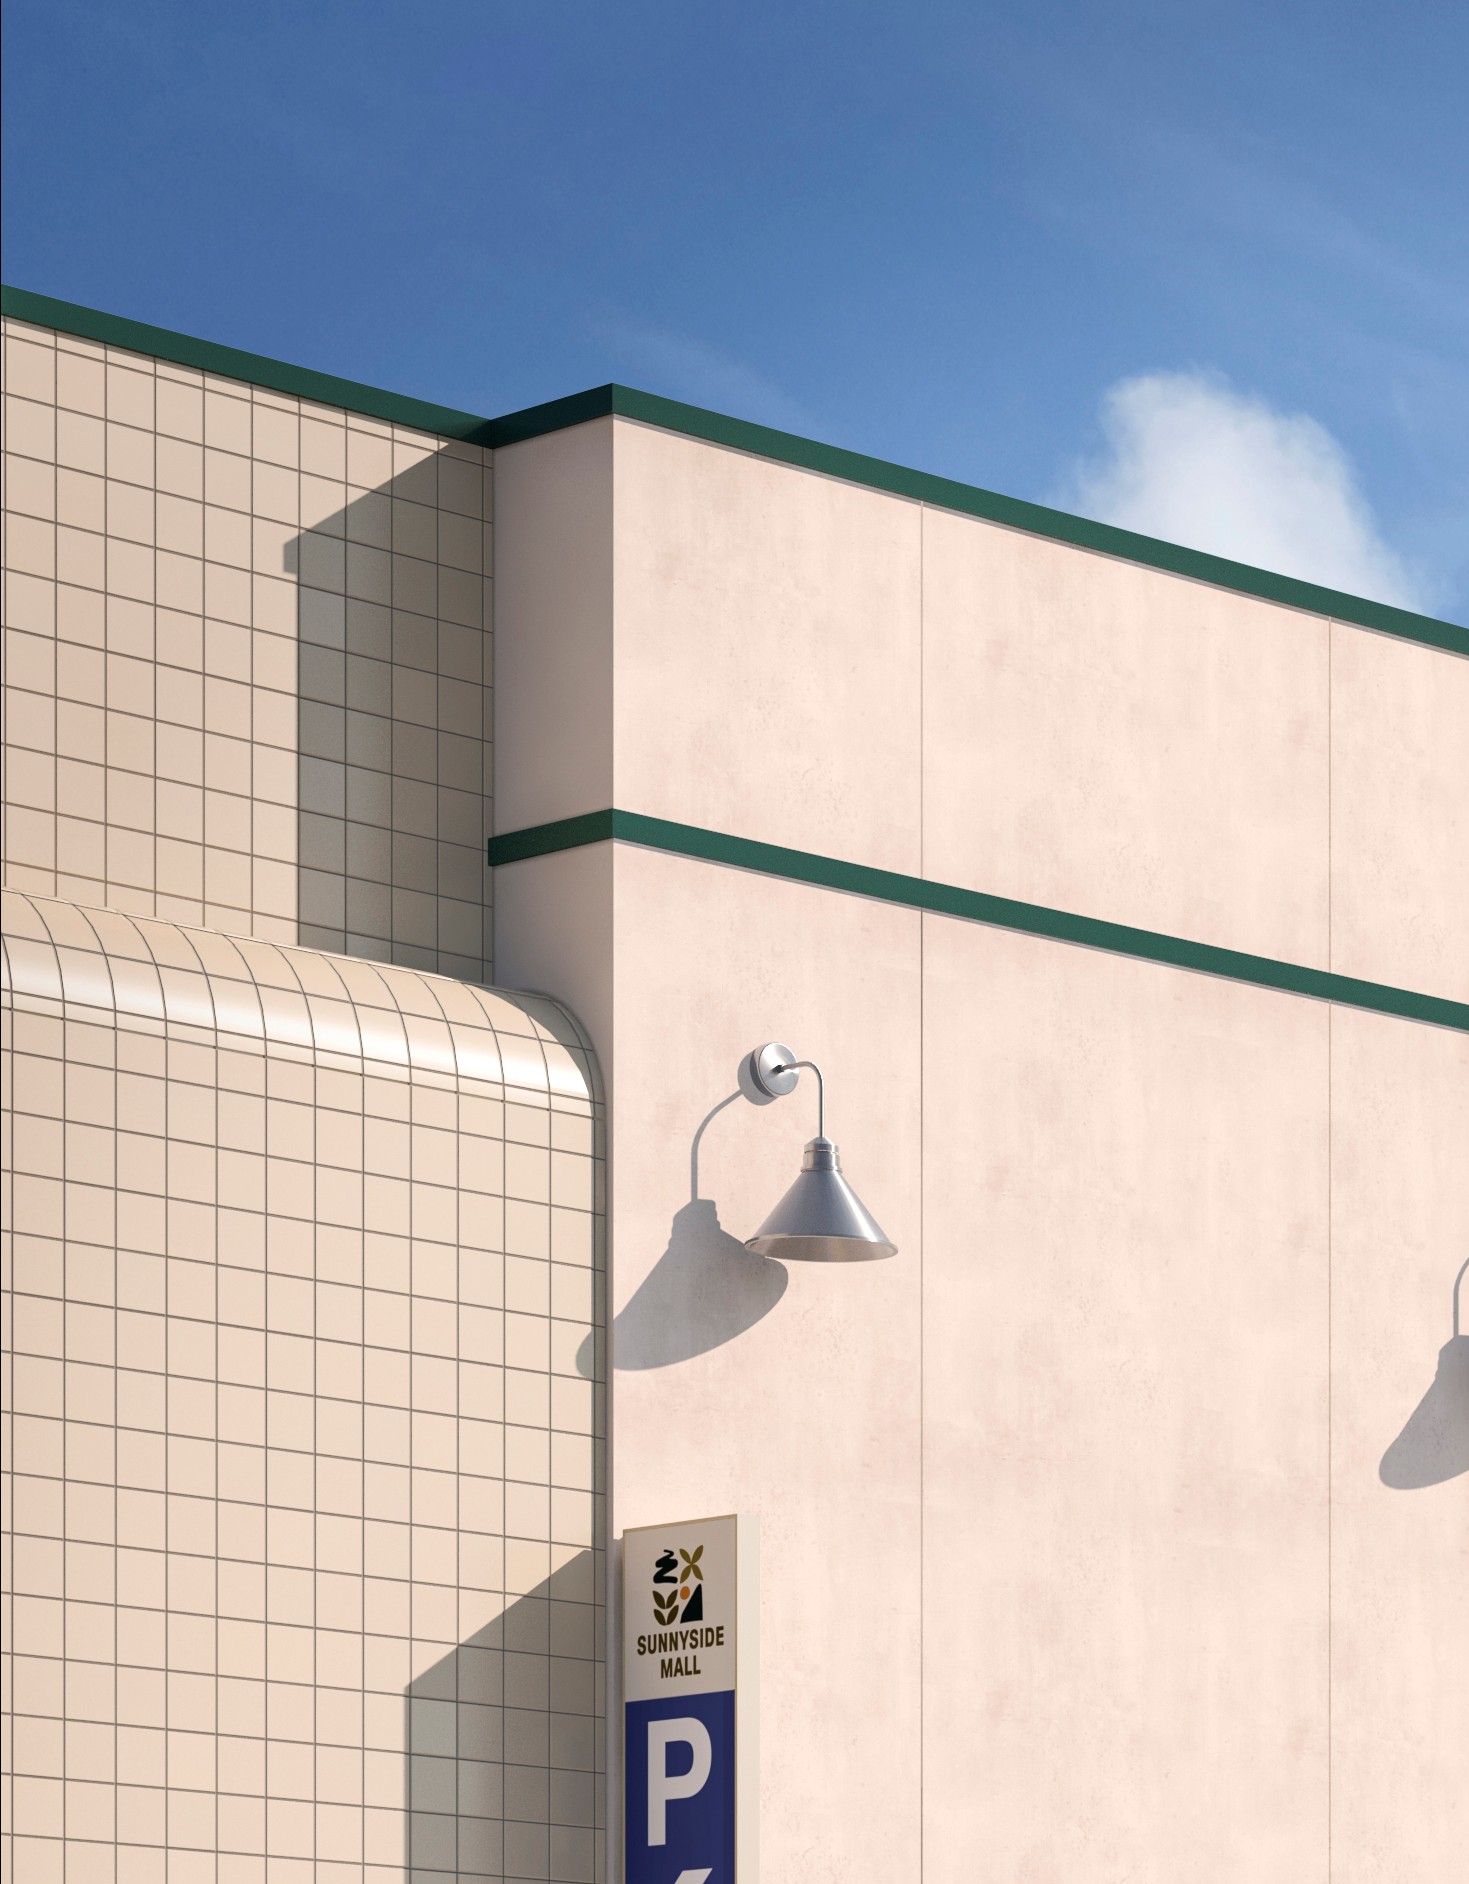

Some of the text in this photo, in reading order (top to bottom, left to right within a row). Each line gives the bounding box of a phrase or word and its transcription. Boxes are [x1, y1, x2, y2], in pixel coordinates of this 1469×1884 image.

[637, 1625, 725, 1656] SUNNYSIDE
[660, 1655, 702, 1679] MALL
[647, 1716, 713, 1847] P
